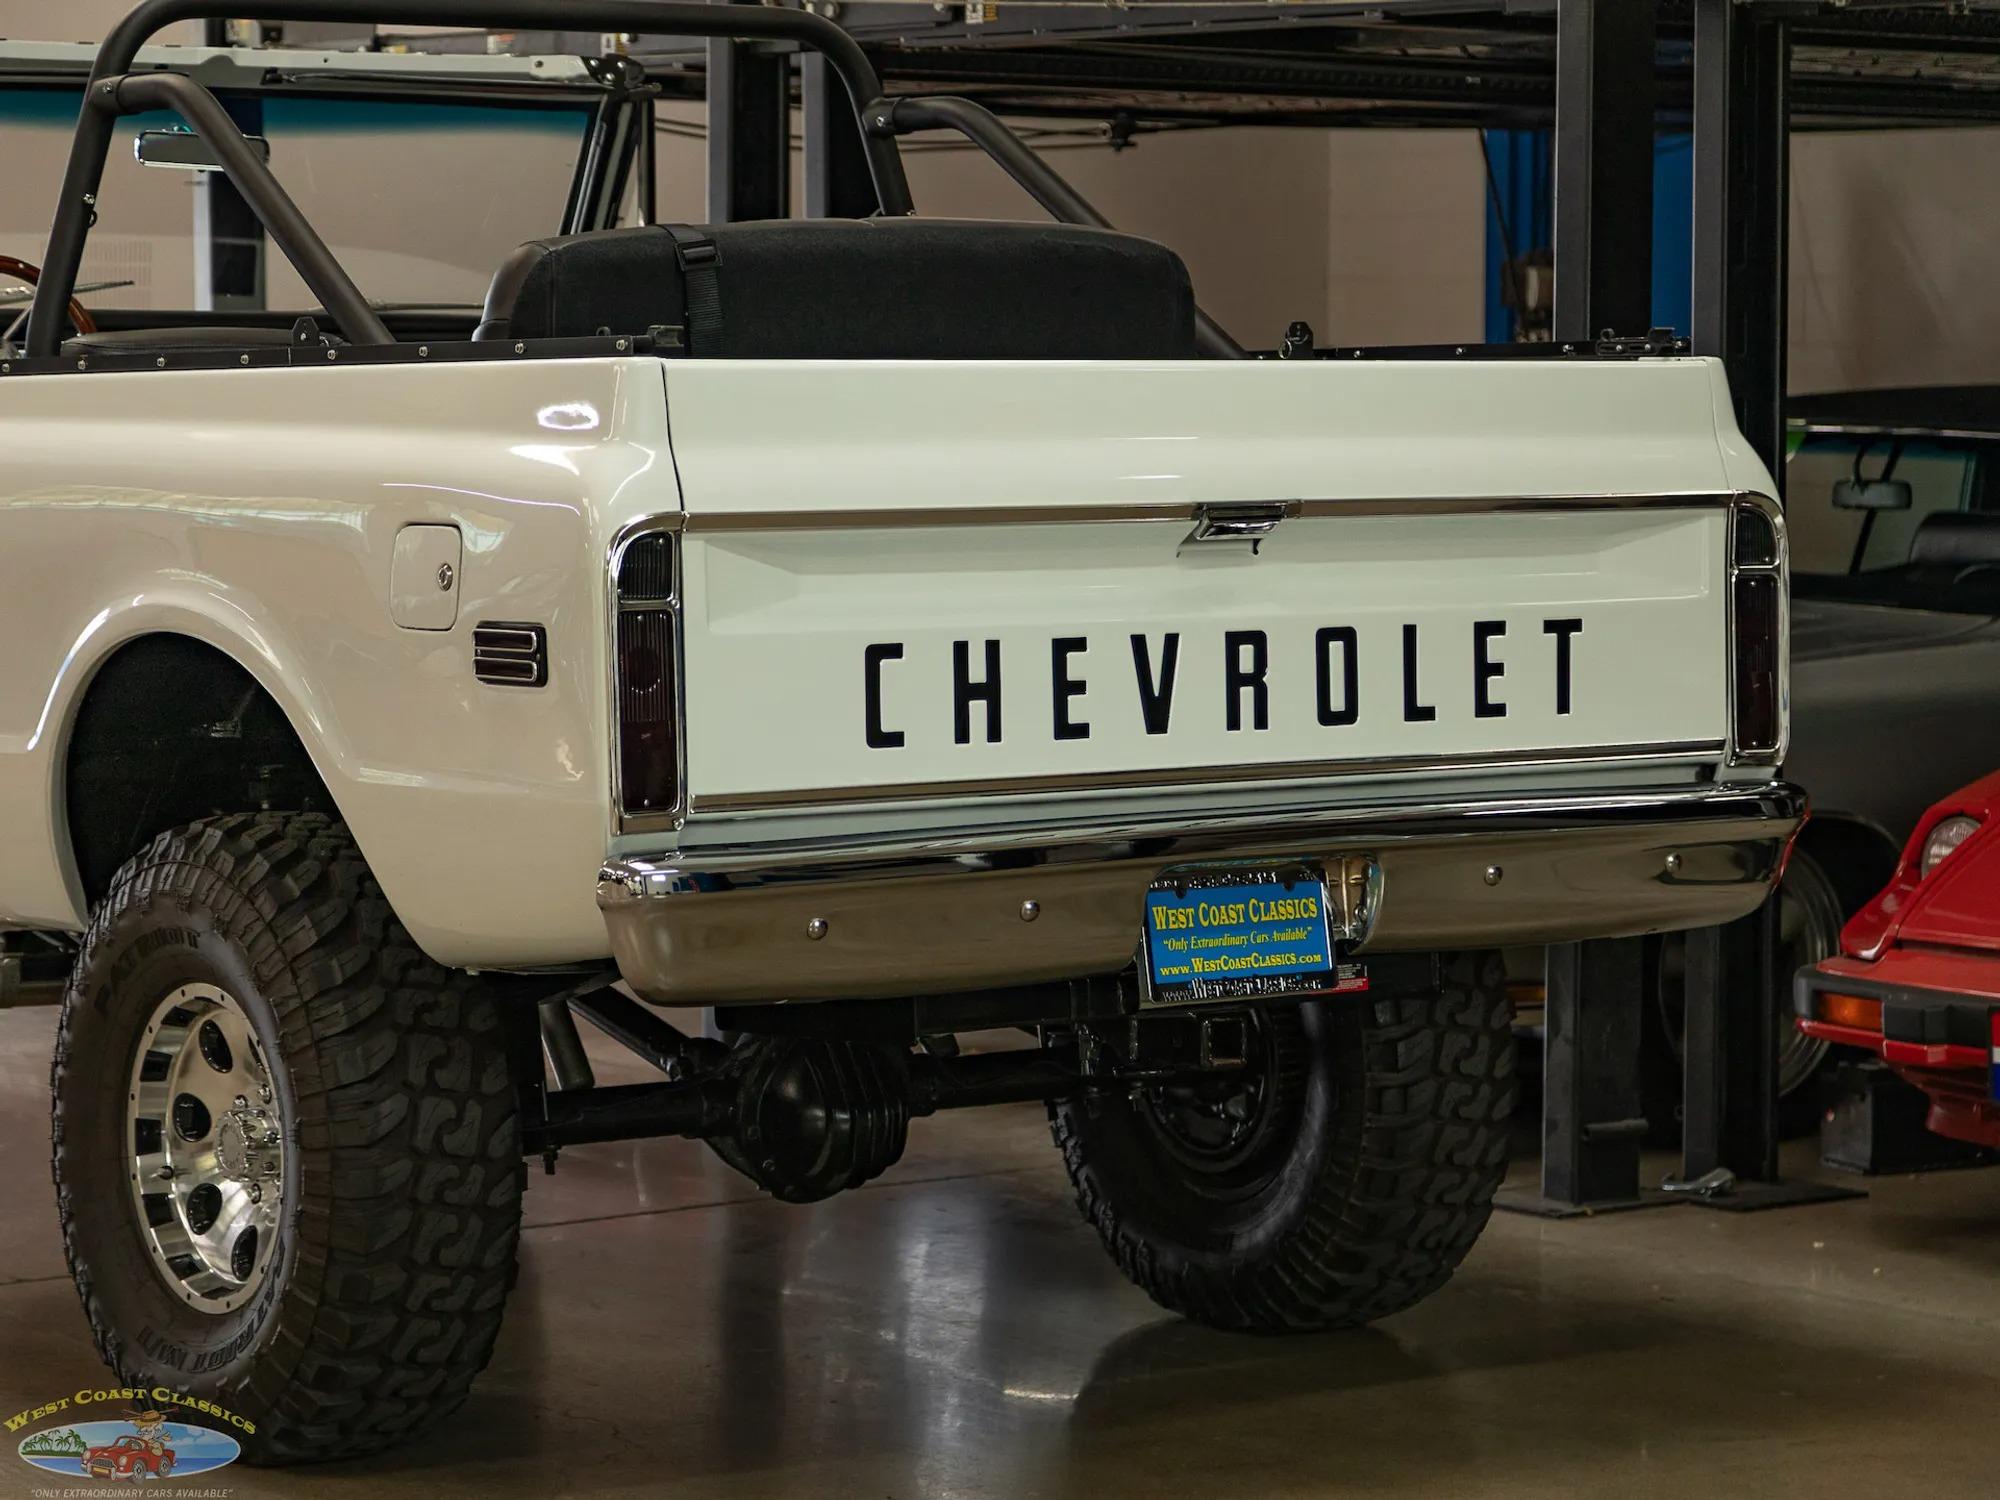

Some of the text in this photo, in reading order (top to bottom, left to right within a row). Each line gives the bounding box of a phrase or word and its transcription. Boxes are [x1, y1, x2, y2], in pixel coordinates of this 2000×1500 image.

[865, 618, 1583, 749] CHEVROLET
[1153, 897, 1318, 930] WEST COAST CLASSICS
[1191, 933, 1249, 951] Extraordinary
[1250, 930, 1270, 944] Cars
